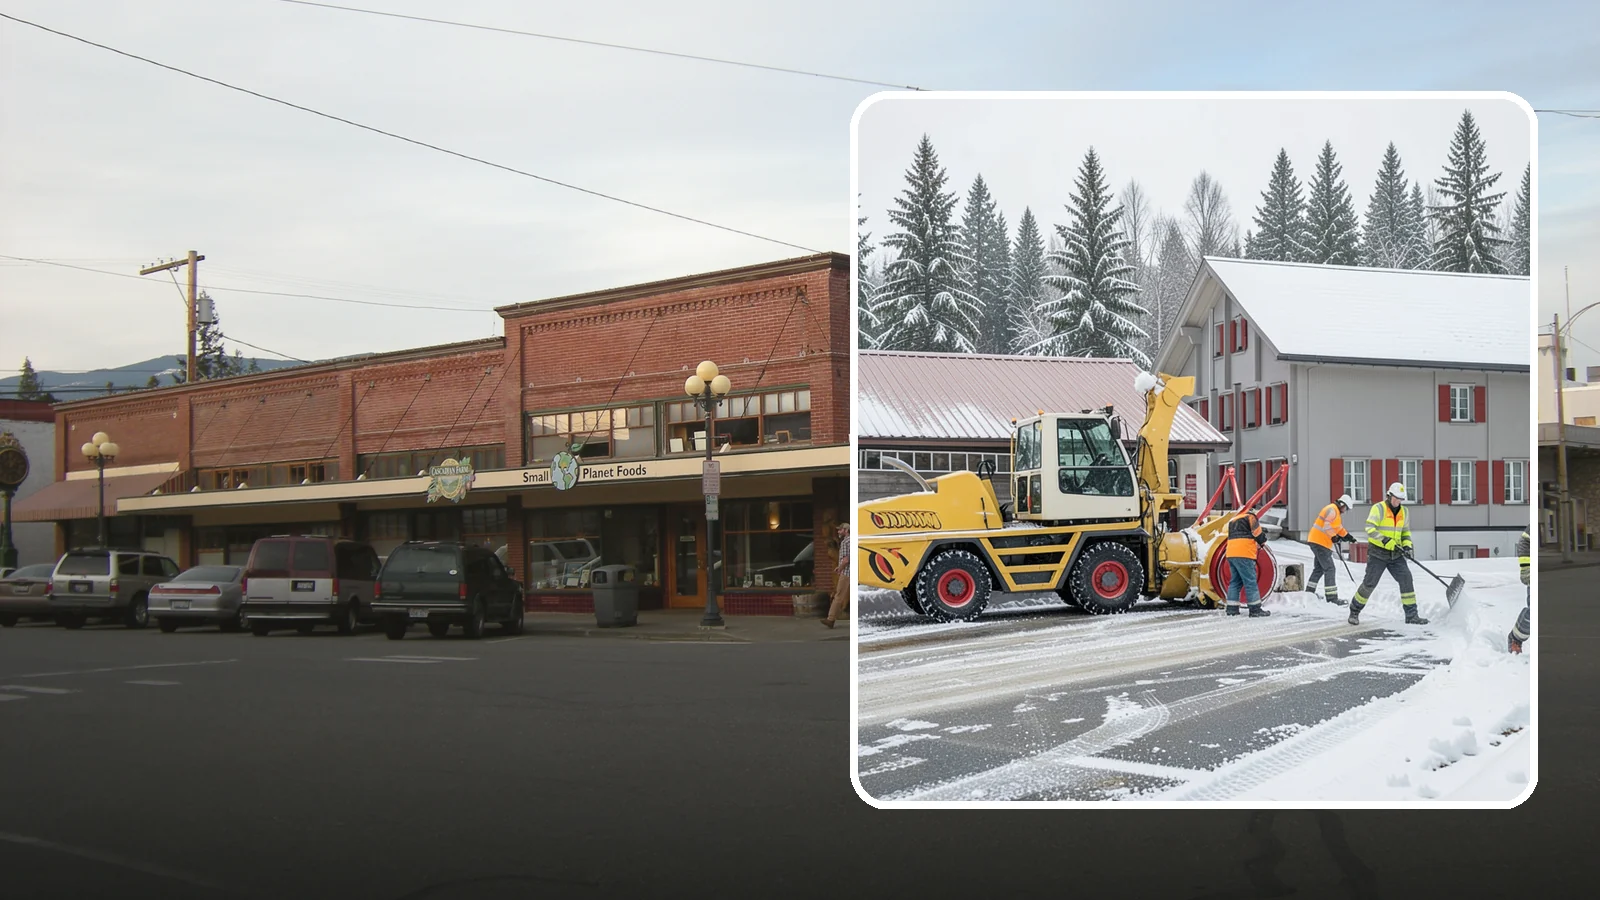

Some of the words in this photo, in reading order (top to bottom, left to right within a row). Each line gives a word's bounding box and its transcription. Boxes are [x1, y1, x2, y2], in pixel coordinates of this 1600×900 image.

[431, 466, 456, 476] CASCADIAN
[522, 470, 549, 483] Small
[582, 466, 614, 479] Planet
[616, 464, 647, 477] Foods
